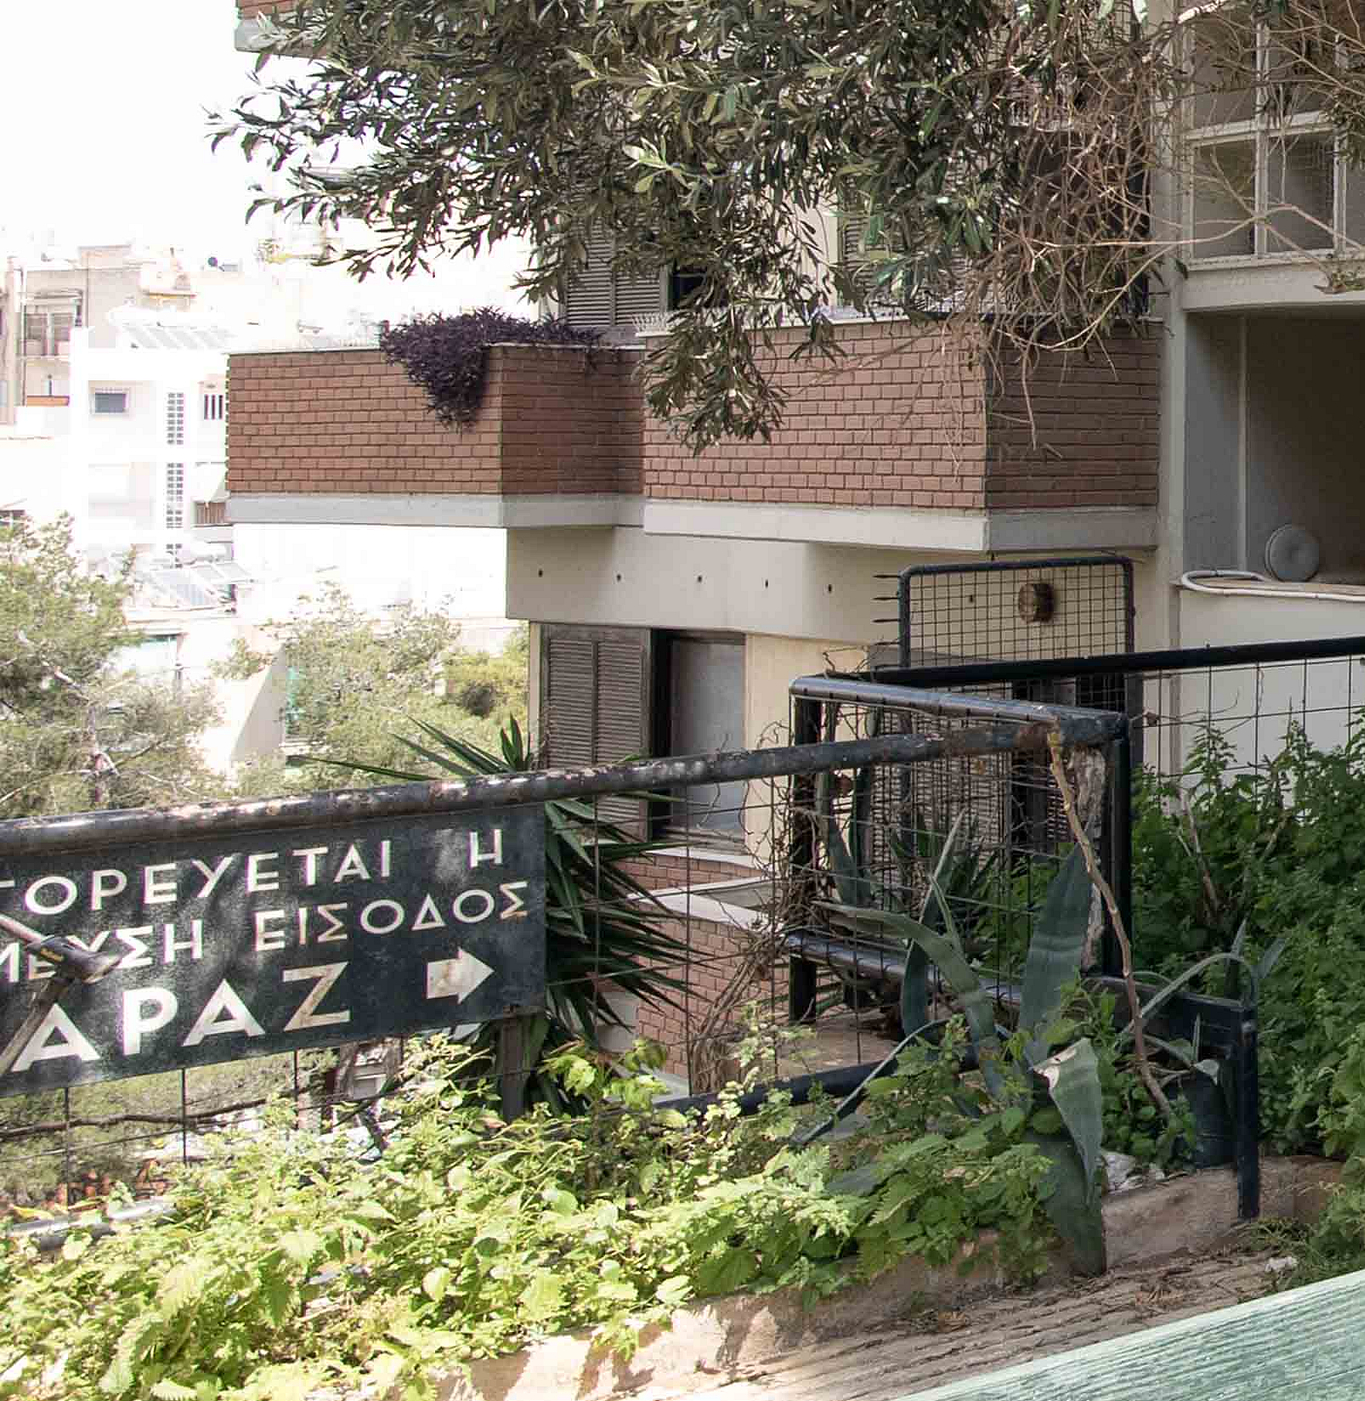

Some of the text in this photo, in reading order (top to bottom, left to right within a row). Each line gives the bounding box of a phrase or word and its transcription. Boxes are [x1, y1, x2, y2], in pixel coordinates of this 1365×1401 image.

[0, 829, 502, 916] ΟΡΕΥΕΤΑΙ Η
[254, 880, 528, 952] ΕΙΣΟΔΟΣ
